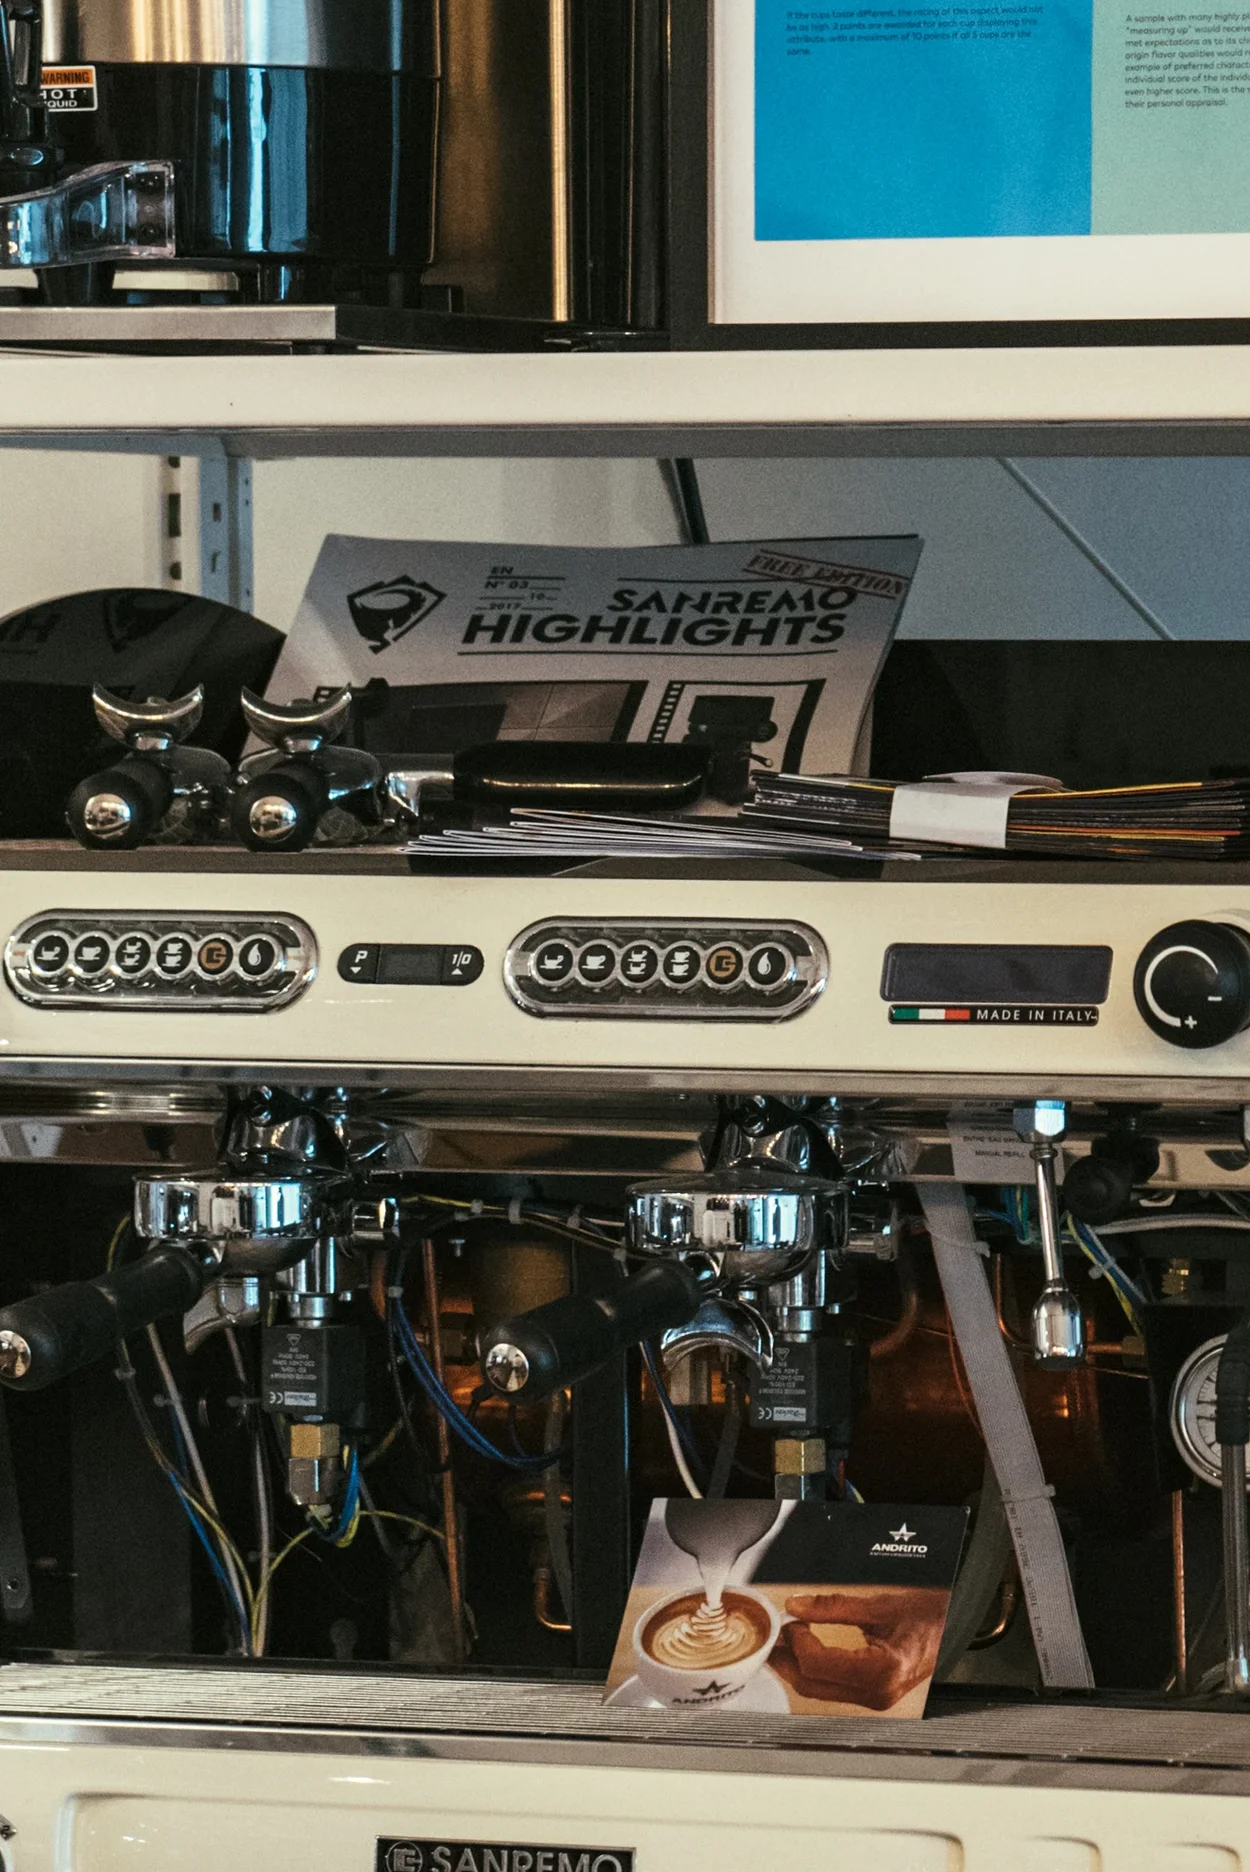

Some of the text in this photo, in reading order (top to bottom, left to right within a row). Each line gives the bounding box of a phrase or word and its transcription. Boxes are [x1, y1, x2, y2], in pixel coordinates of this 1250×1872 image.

[44, 100, 77, 108] QUID
[491, 567, 514, 575] EN
[749, 554, 908, 595] FREE EDITION
[606, 586, 858, 615] SANREMO
[461, 612, 847, 647] HIGHLIGHTS
[355, 950, 369, 964] P
[976, 1009, 1092, 1021] MADE IN ITALY
[871, 1543, 928, 1554] ANDRITO
[432, 1845, 622, 1872] SANREMO
